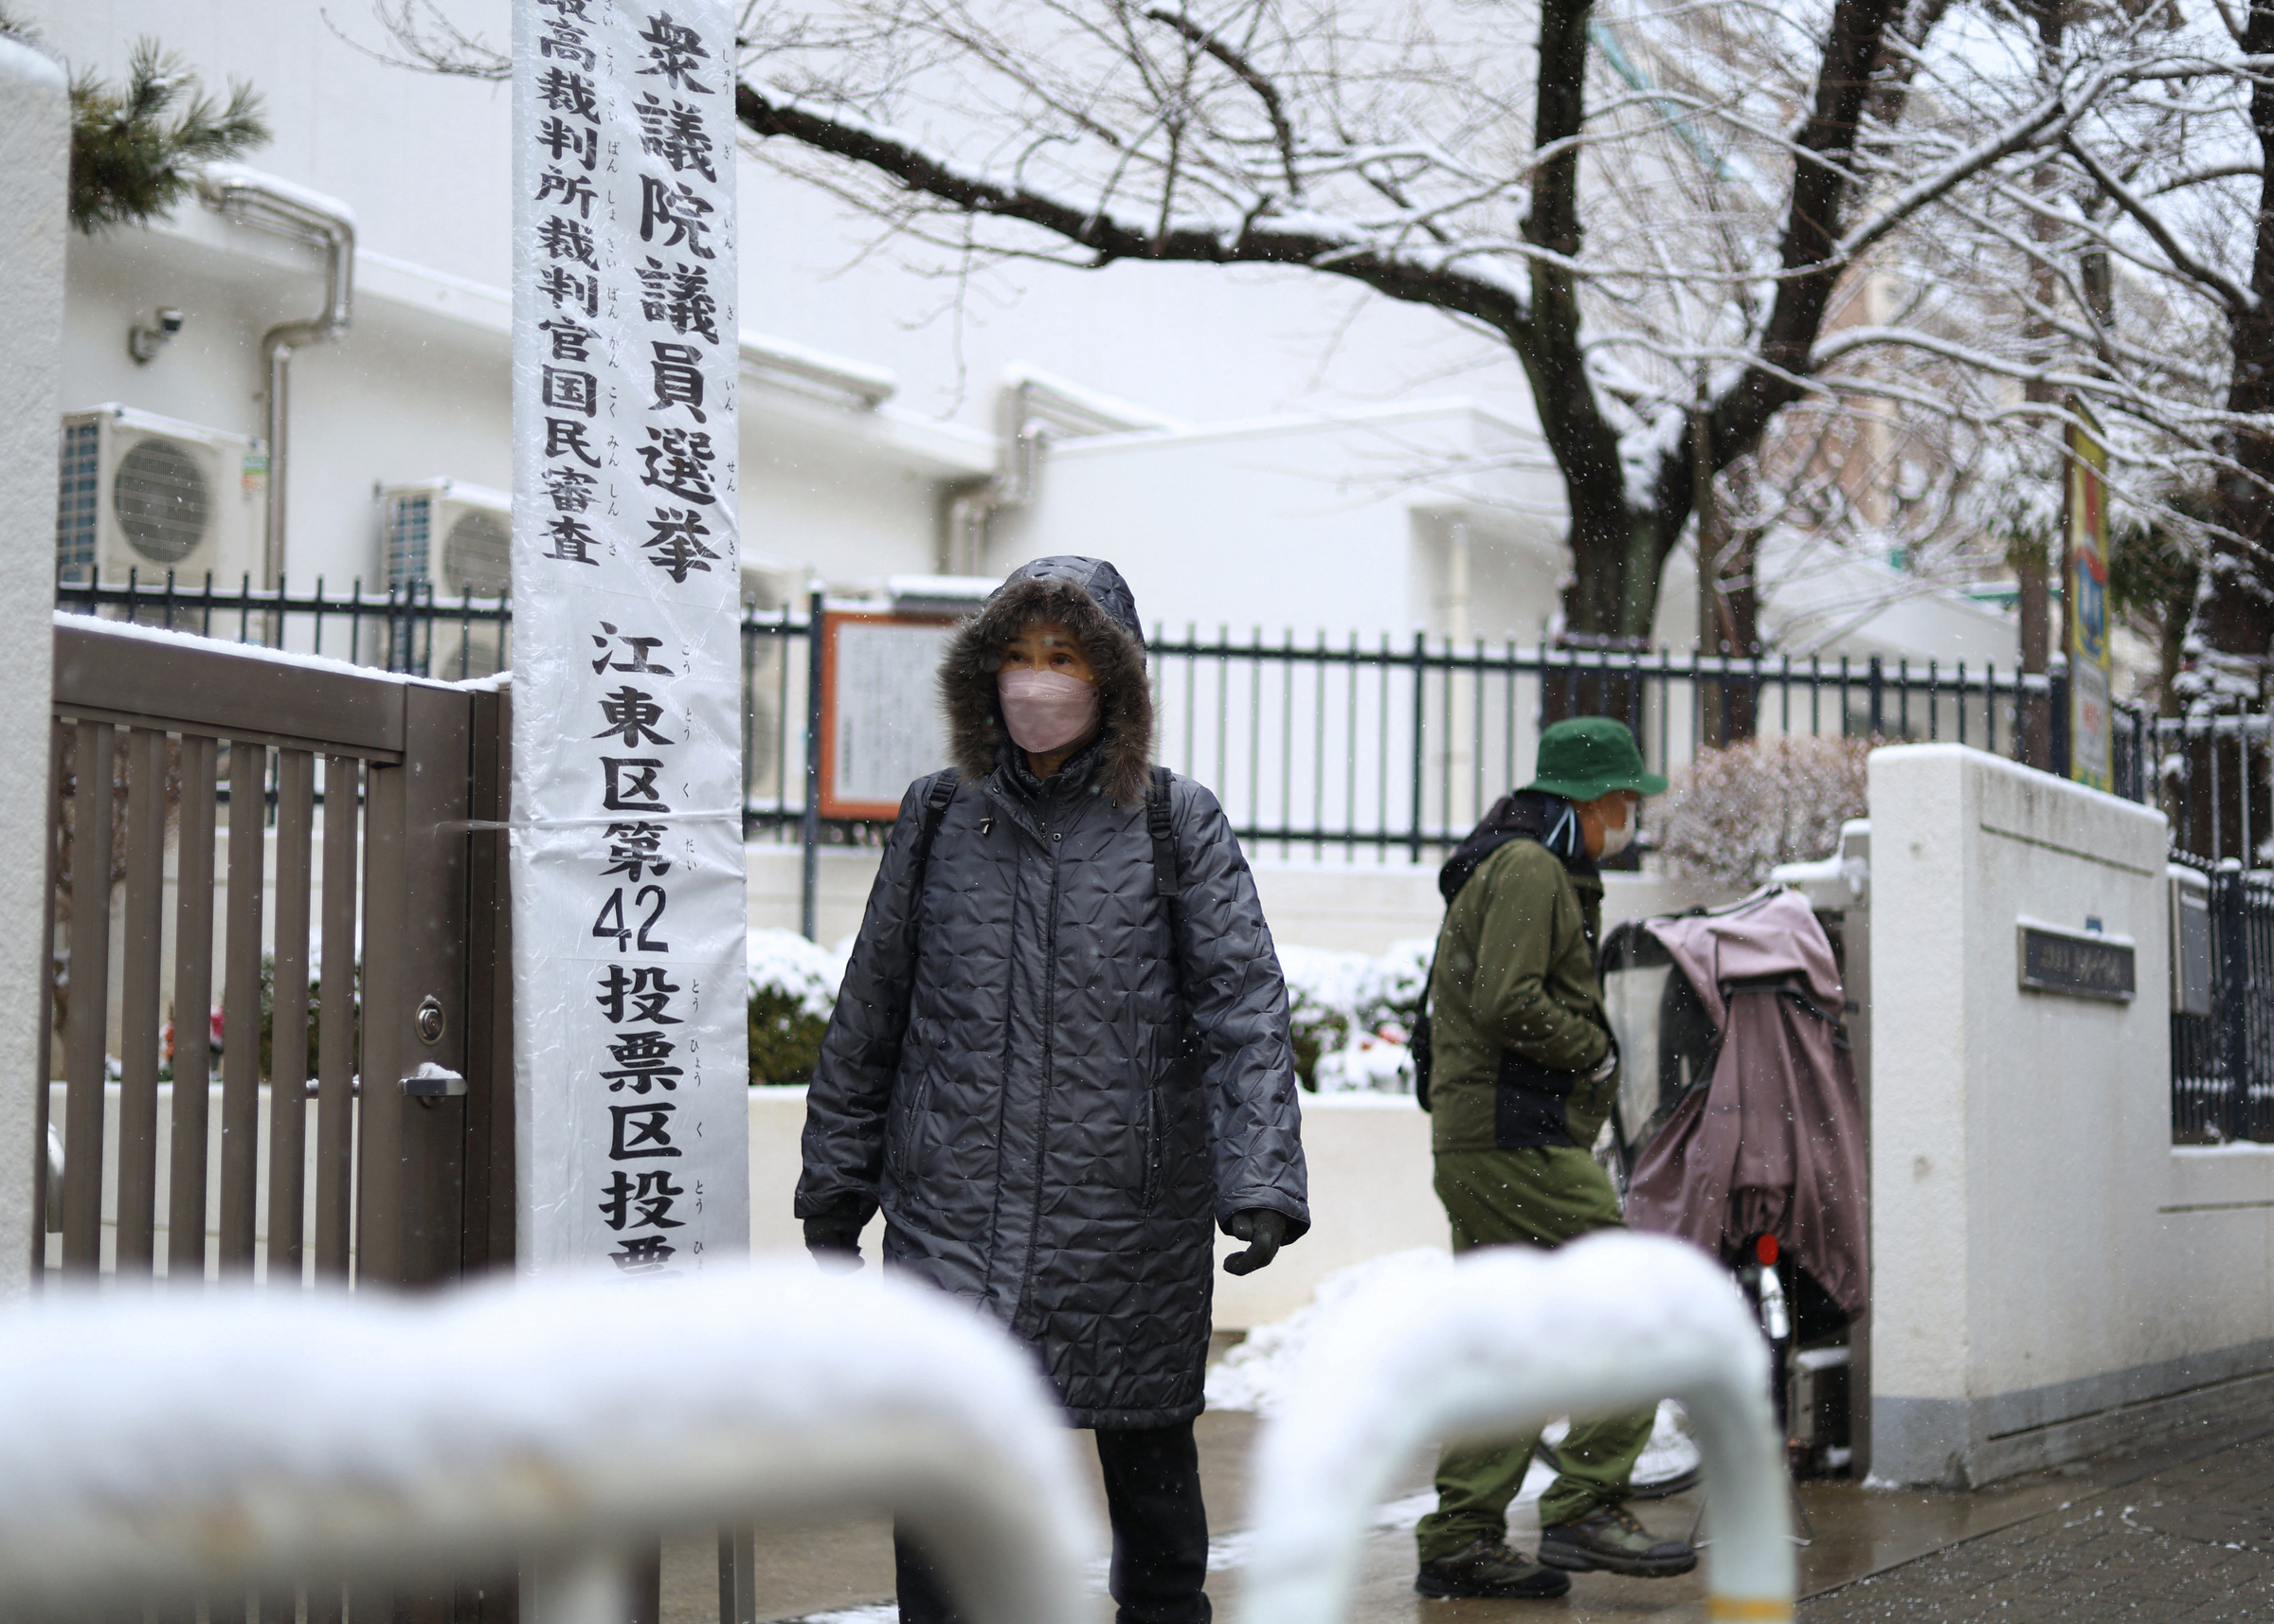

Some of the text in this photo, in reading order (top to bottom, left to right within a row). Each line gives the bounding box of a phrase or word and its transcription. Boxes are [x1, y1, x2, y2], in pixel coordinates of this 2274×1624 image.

[632, 9, 722, 584] 衆議院議員選挙
